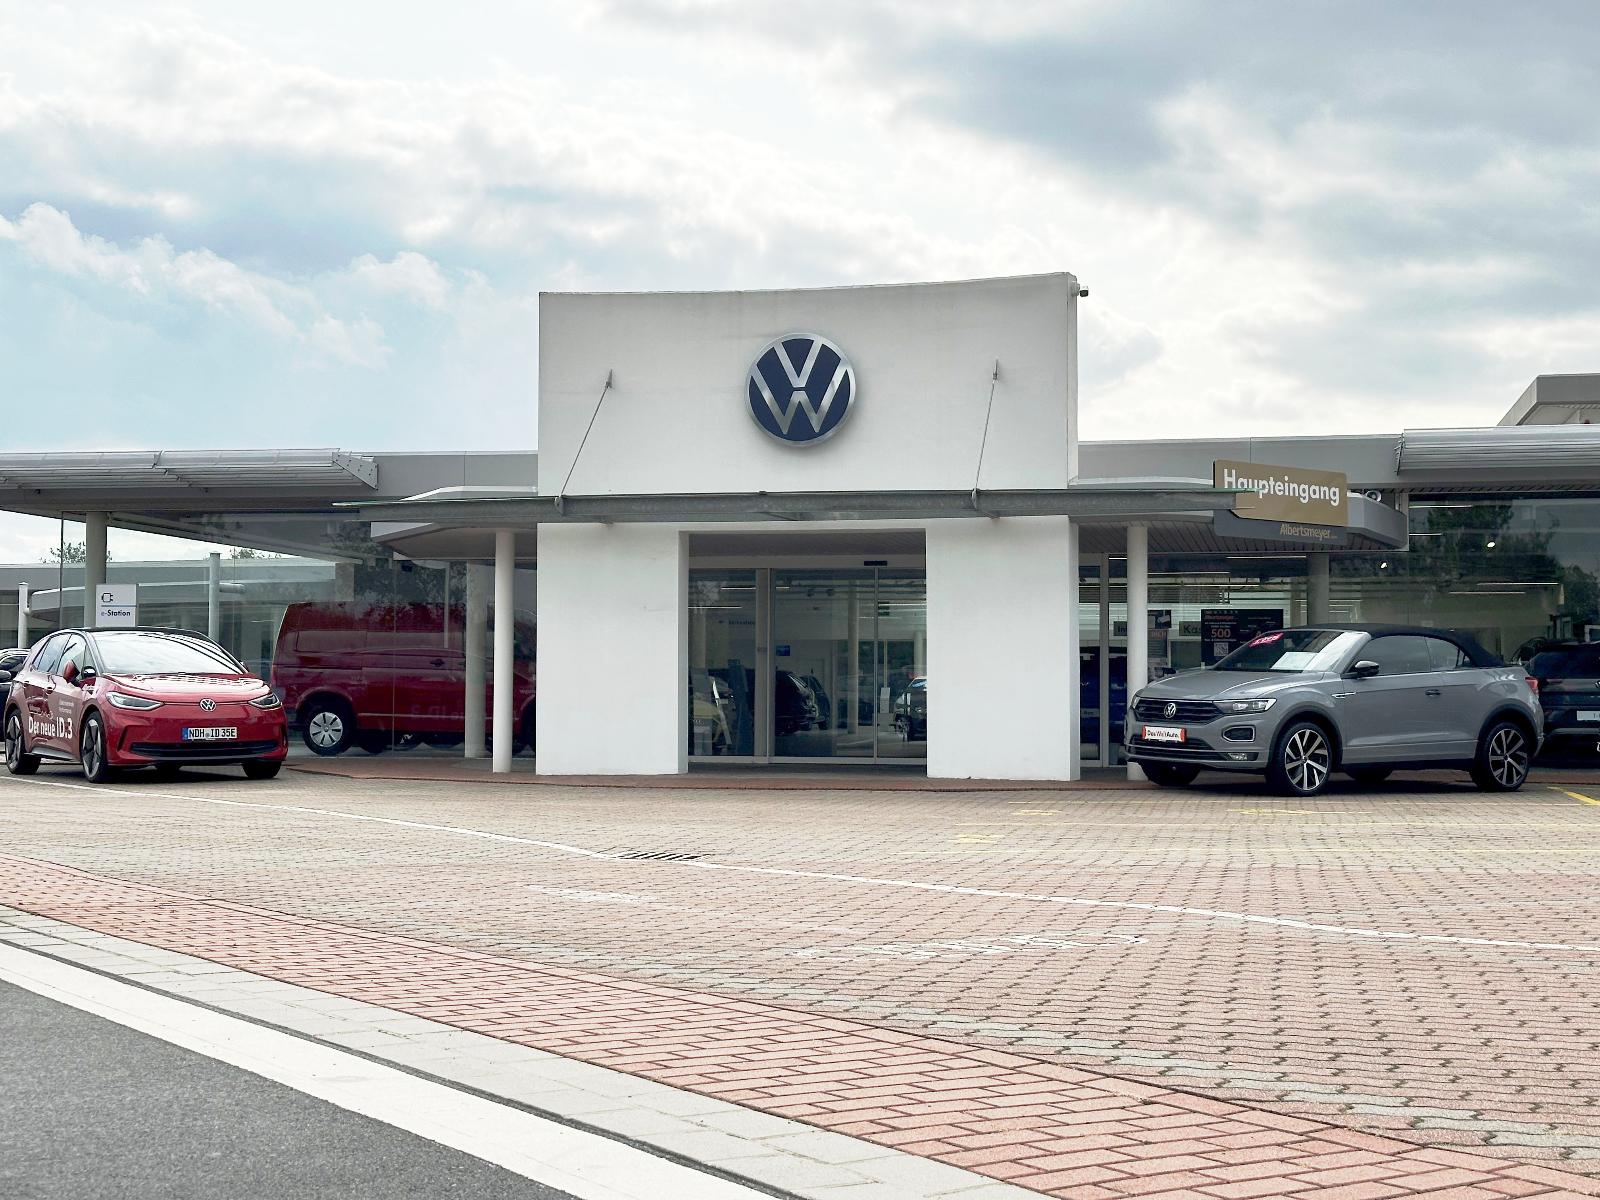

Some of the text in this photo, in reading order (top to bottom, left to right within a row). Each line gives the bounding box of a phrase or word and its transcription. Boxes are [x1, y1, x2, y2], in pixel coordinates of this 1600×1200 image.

[1223, 468, 1340, 507] Haupteingang
[1280, 523, 1330, 541] Albertsmeyer
[101, 609, 131, 617] e-Station
[1211, 628, 1231, 638] 500
[28, 716, 73, 739] Der neue ID.3
[189, 728, 236, 738] NDH ID 35E
